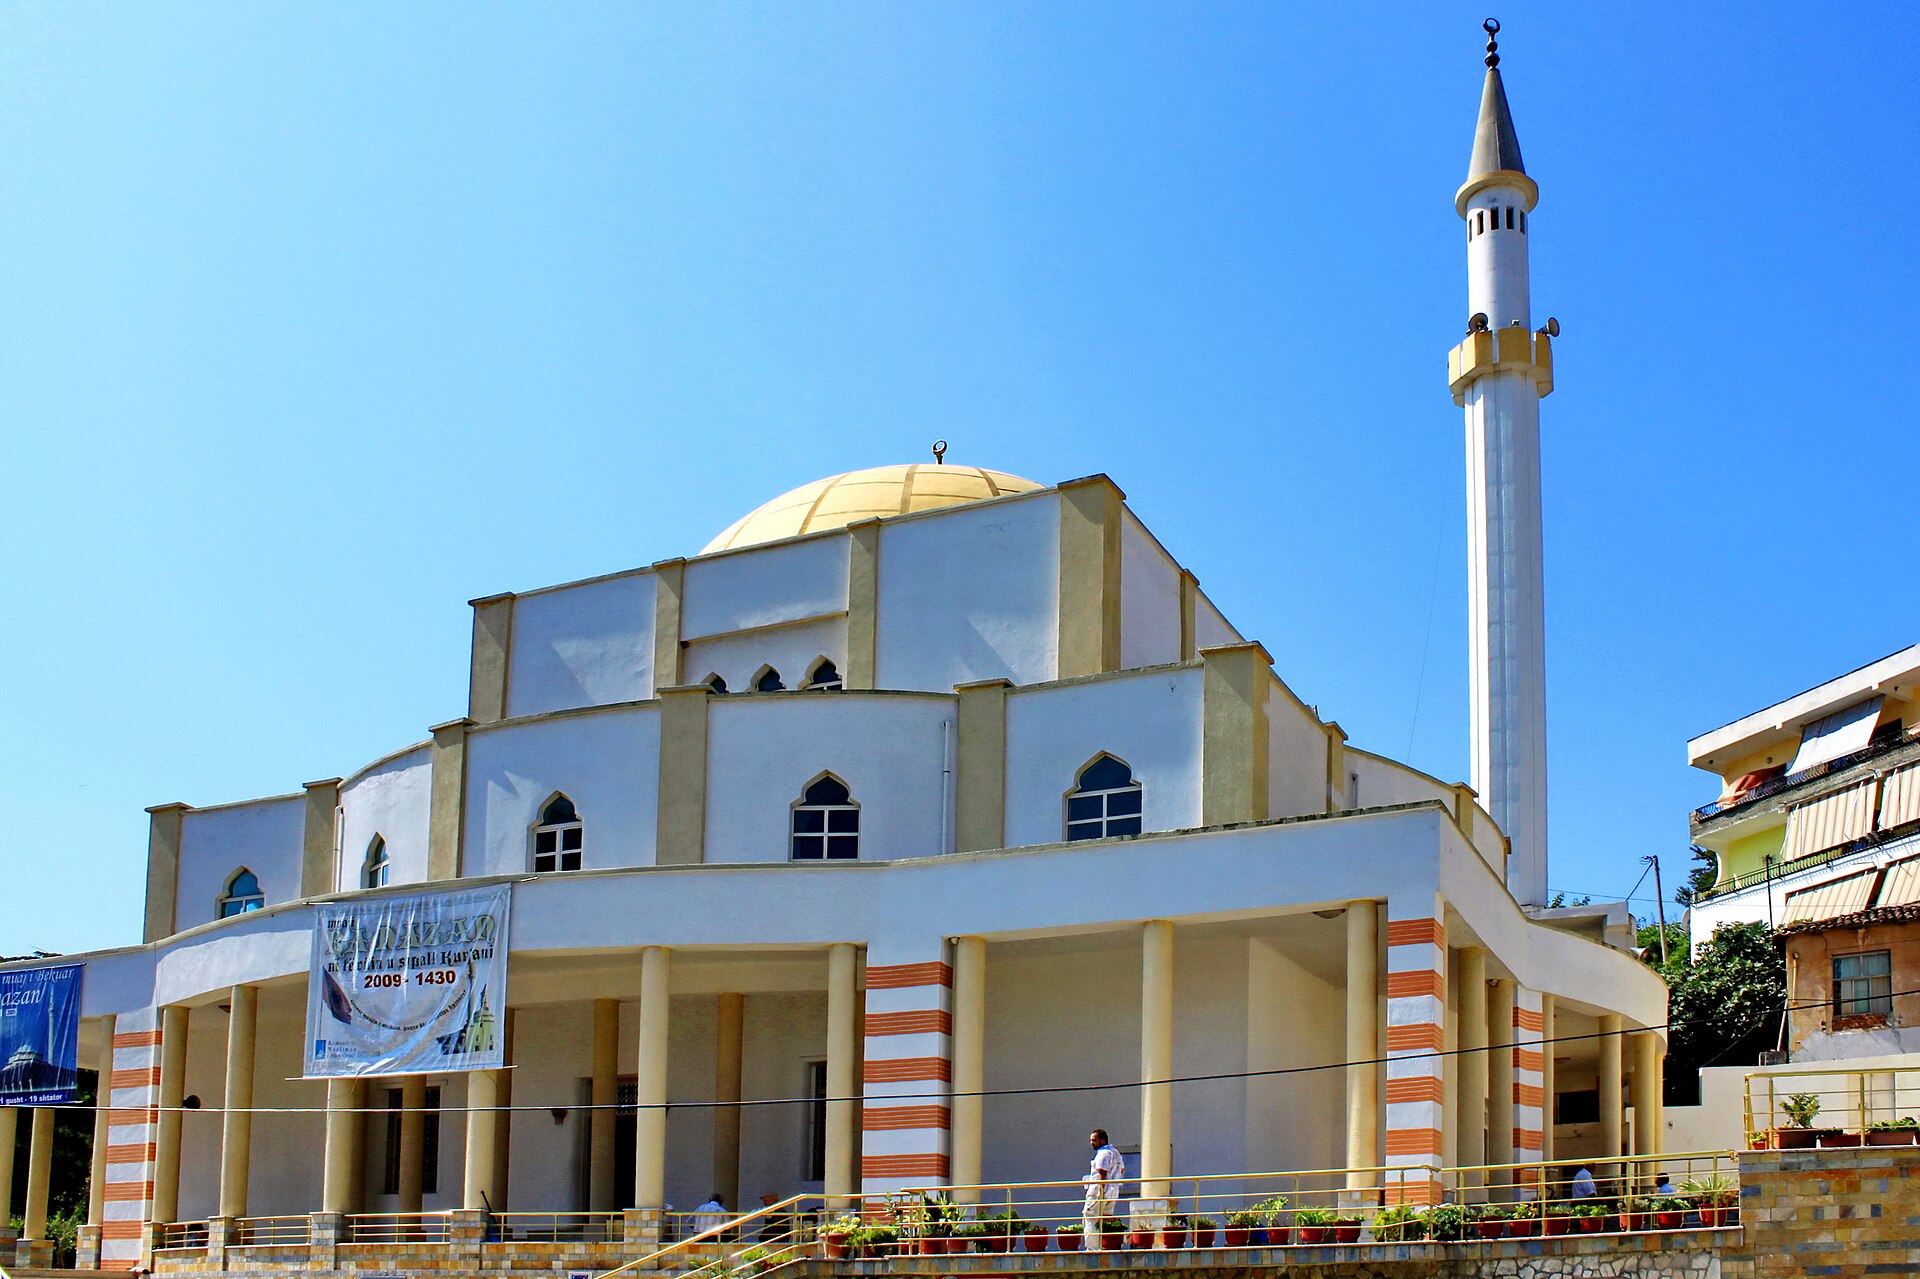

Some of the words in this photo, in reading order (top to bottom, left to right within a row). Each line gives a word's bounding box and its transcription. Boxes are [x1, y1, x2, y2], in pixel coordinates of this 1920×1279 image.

[327, 916, 355, 929] muai
[36, 968, 74, 984] Bekuar
[364, 973, 402, 988] 2009
[415, 969, 456, 985] 1430
[0, 989, 41, 1007] azan
[6, 1097, 23, 1105] gusht
[39, 1094, 63, 1102] shtator
